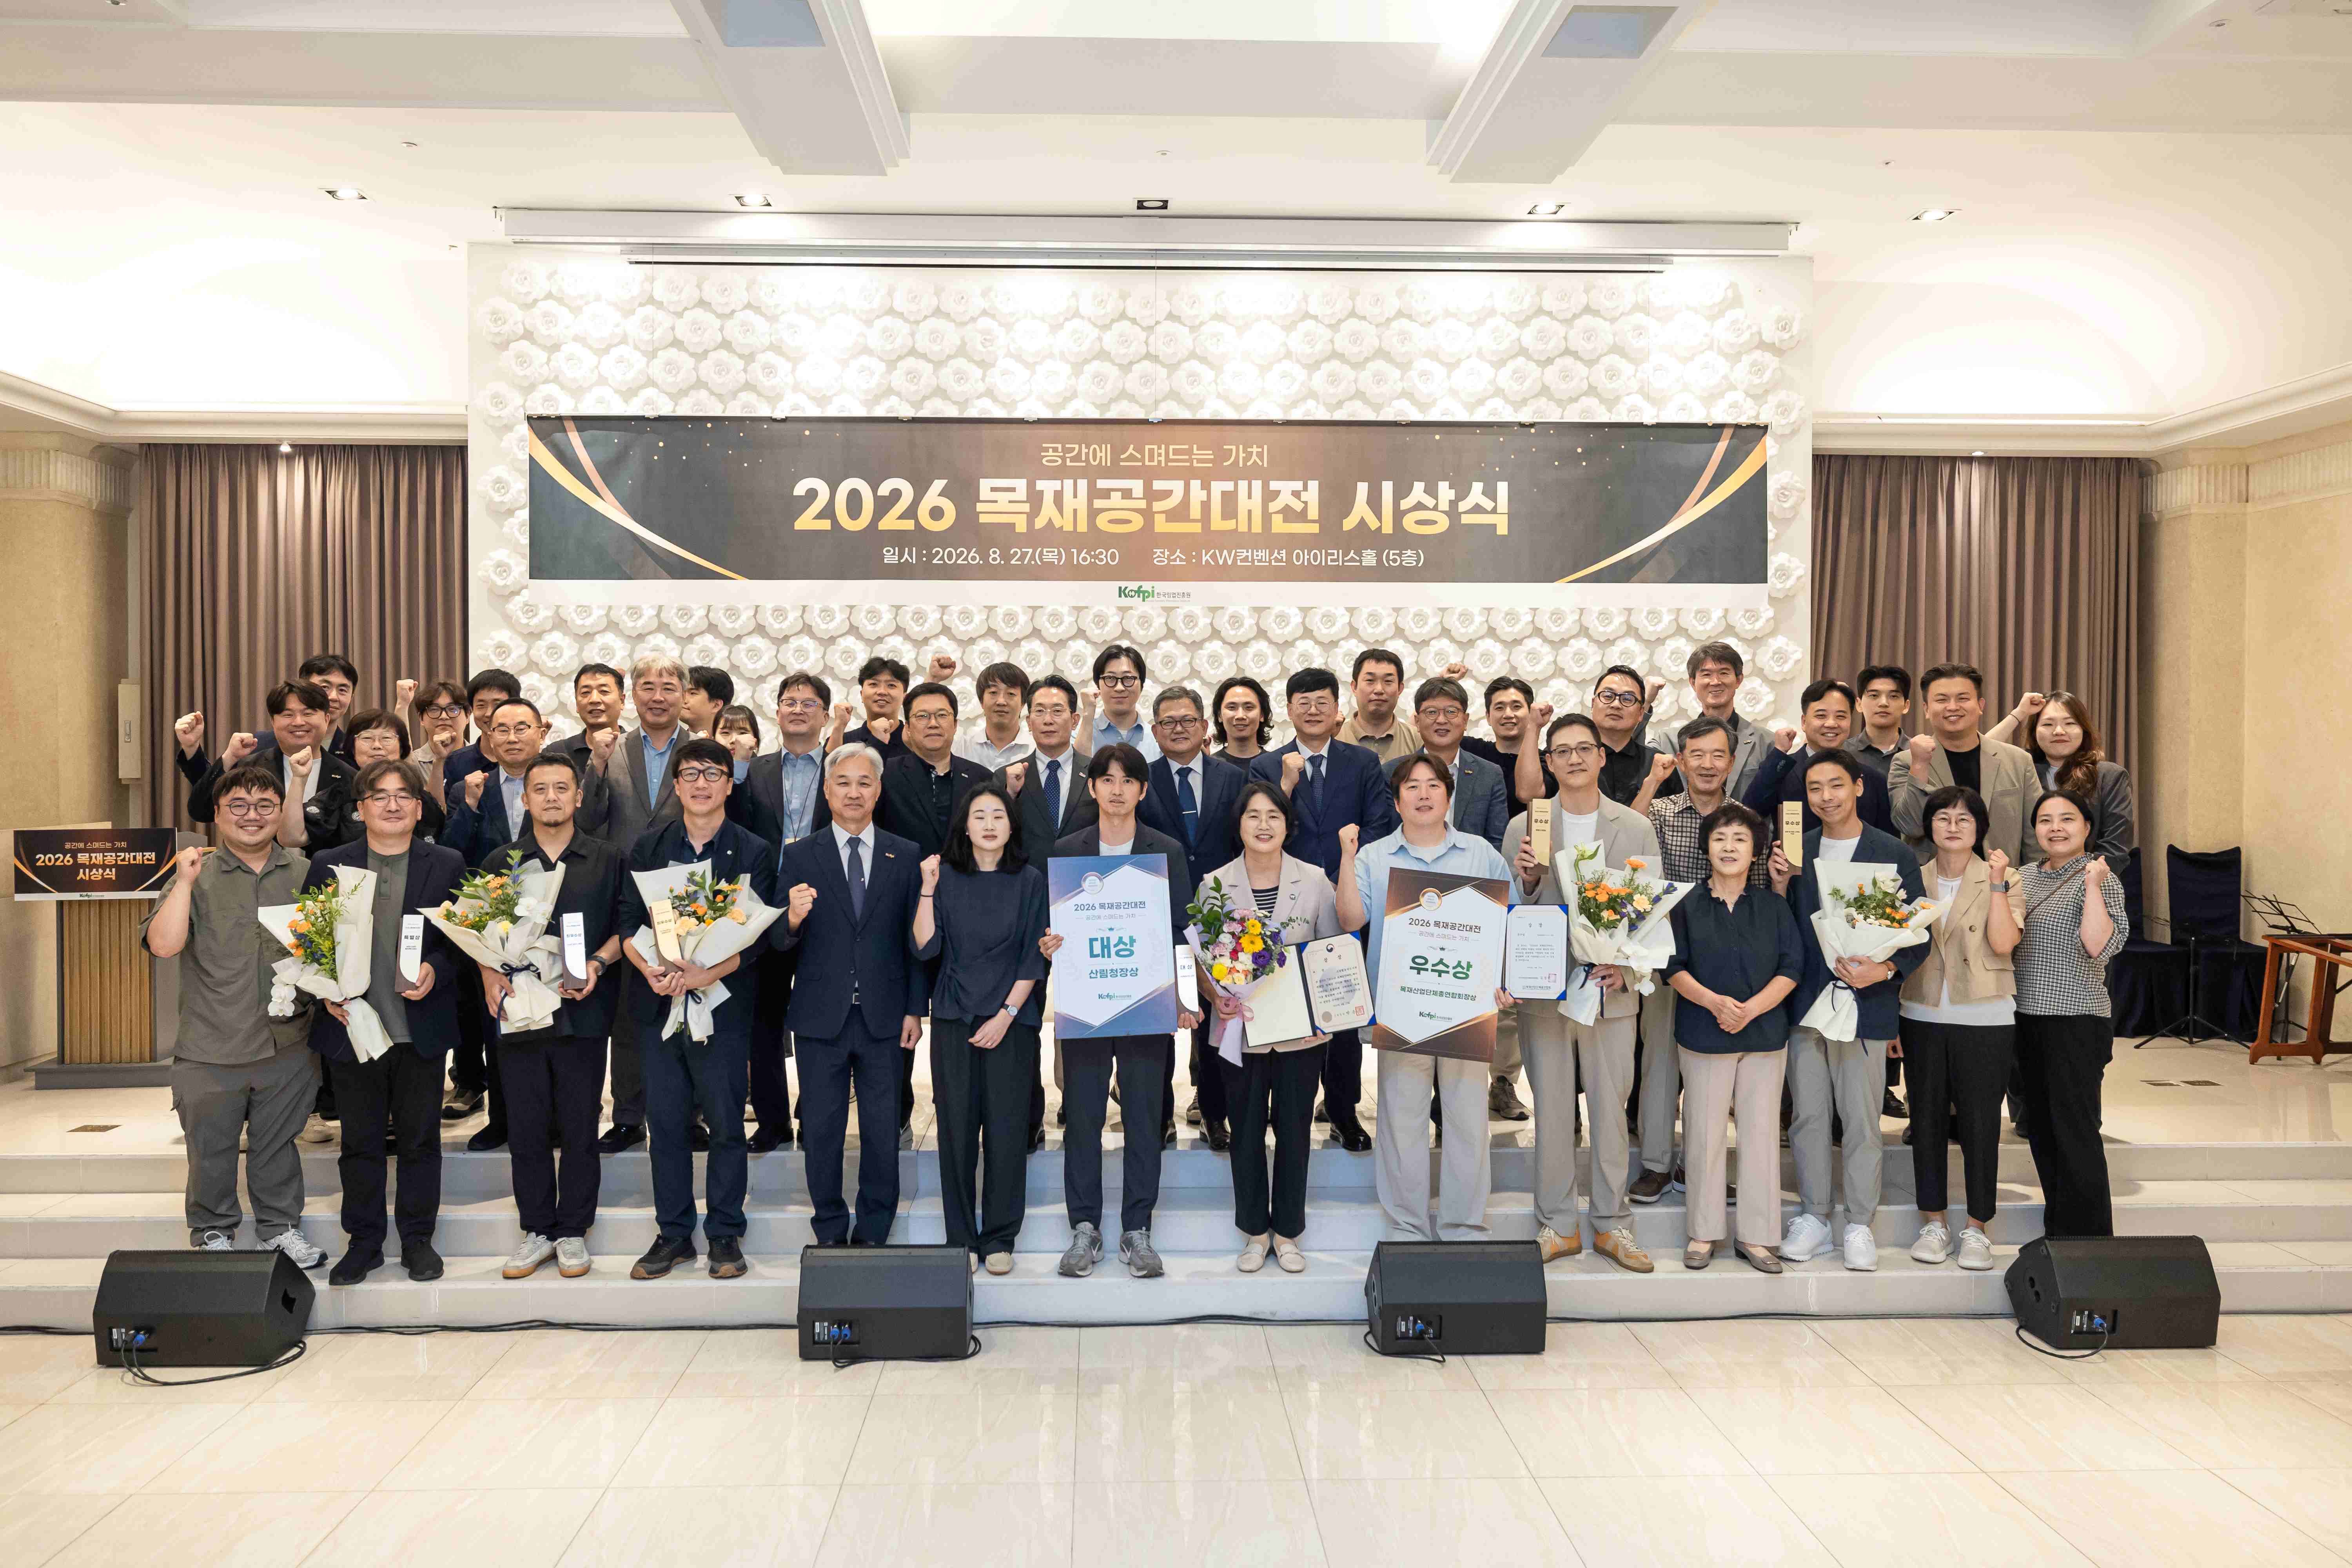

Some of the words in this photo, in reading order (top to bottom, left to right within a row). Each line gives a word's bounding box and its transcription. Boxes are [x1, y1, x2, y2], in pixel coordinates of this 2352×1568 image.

[1040, 443, 1111, 466] 공간에
[1119, 444, 1214, 467] 스며드는
[1223, 445, 1268, 468] 가치
[793, 477, 956, 532] 2026
[975, 478, 1320, 534] 목재공간대전
[1342, 481, 1508, 535] 시상식
[883, 547, 916, 564] 일시
[932, 548, 983, 565] 2026.
[989, 548, 1004, 565] 8.
[1010, 547, 1065, 567] 27.(목)
[1071, 549, 1119, 565] 16:30
[1152, 549, 1186, 566] 장소
[1201, 549, 1287, 566] KW컨벤션
[1292, 549, 1377, 567] 아이리스홀
[1382, 549, 1424, 567] (5층)
[1118, 585, 1154, 602] Kofpi
[36, 853, 73, 866] 2026
[77, 852, 156, 865] 목재공간대전
[77, 868, 116, 880] 시상식
[1074, 903, 1096, 911] 2026
[1098, 901, 1146, 910] 목재공간대전
[1408, 918, 1430, 927] 2026
[1433, 920, 1481, 933] 목재공간대전
[1089, 935, 1136, 958] 대상
[1089, 967, 1139, 979] 산림청장상
[1410, 955, 1473, 980] 우수상
[1400, 986, 1477, 1001] 목재산업단체총연합회장상
[1419, 1011, 1436, 1020] Kofpi
